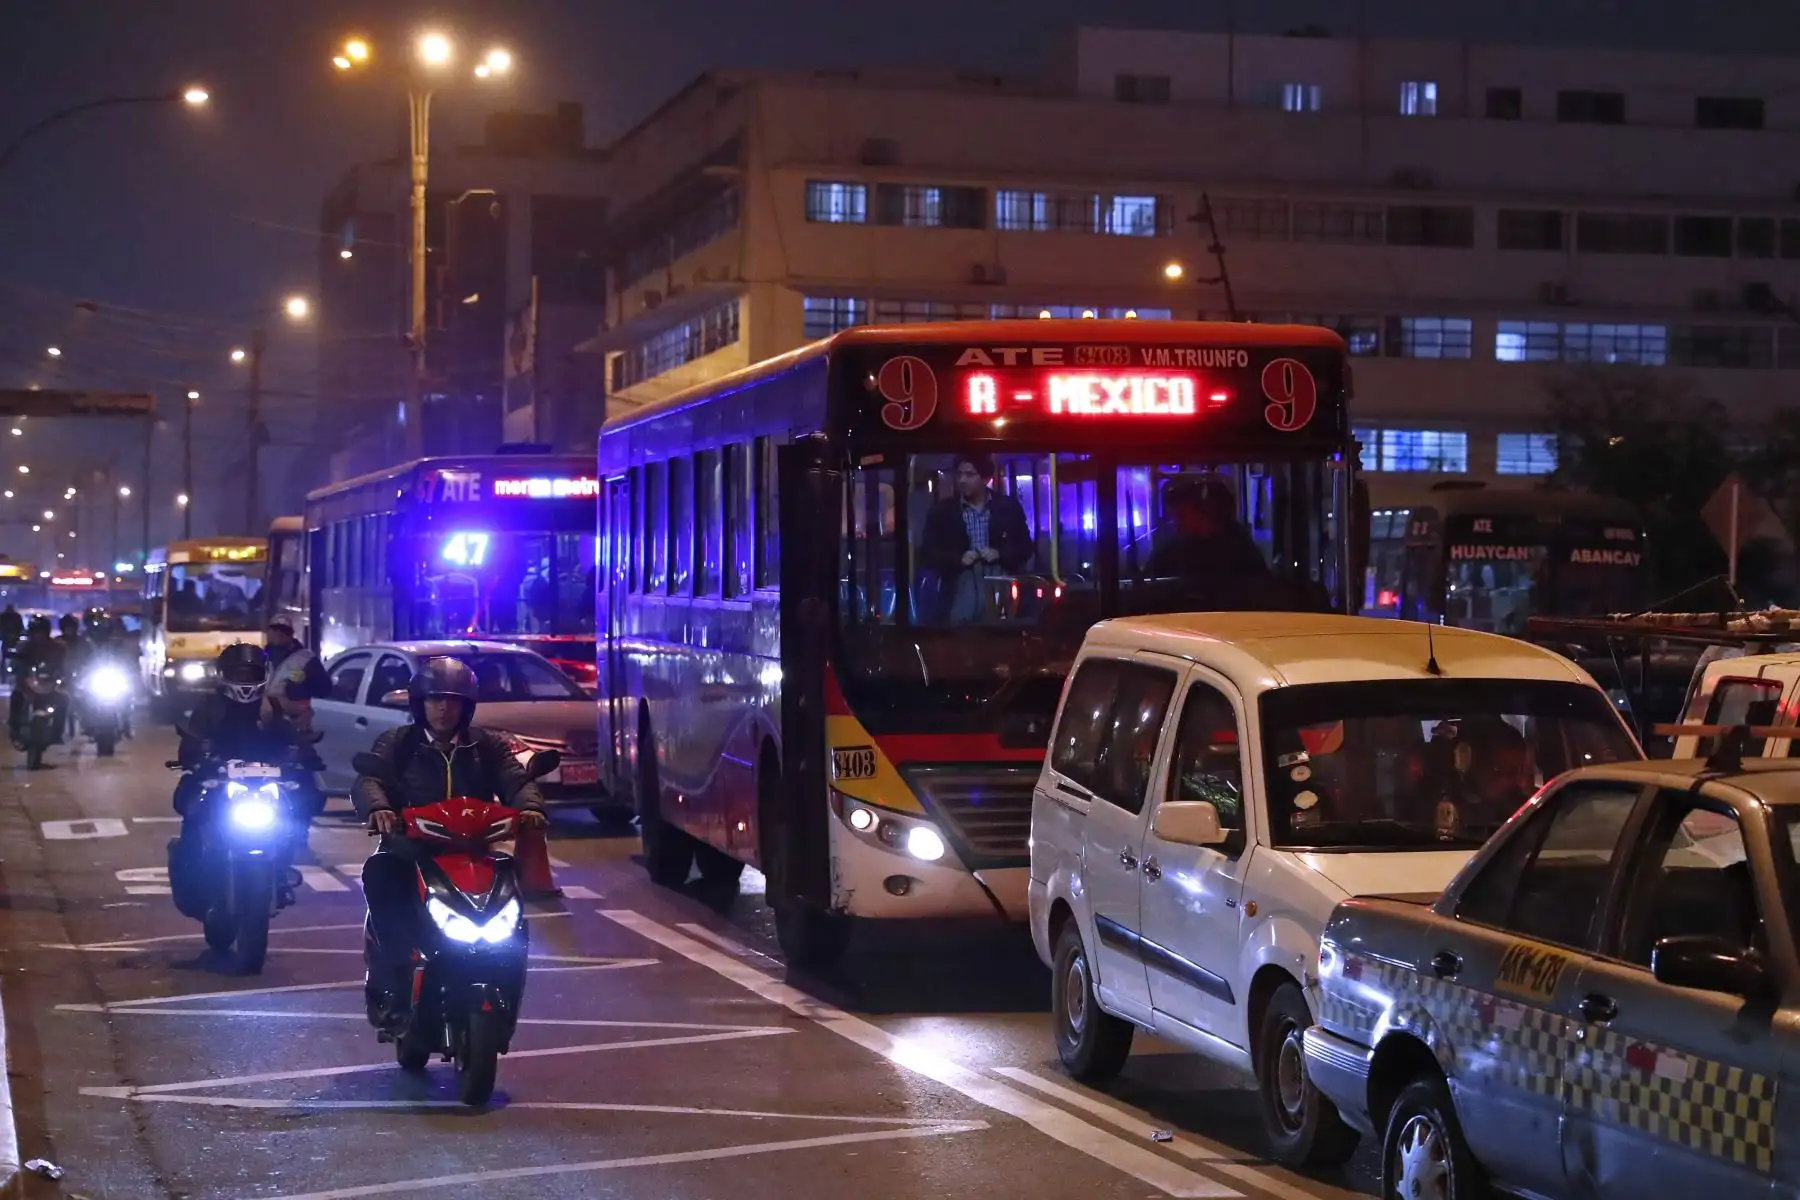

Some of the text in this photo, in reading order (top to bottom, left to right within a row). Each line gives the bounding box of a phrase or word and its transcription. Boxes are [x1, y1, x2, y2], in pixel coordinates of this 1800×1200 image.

[954, 347, 1064, 366] ATE
[1141, 348, 1249, 368] V.M.TRIUNFO
[878, 355, 938, 431] 9
[1049, 374, 1196, 415] MEXICO
[1261, 357, 1317, 432] 9
[442, 472, 481, 501] ATE
[442, 531, 489, 566] 47
[1451, 544, 1529, 561] HUAYCAN
[1570, 548, 1641, 566] ABANCAY
[834, 750, 876, 779] 8403
